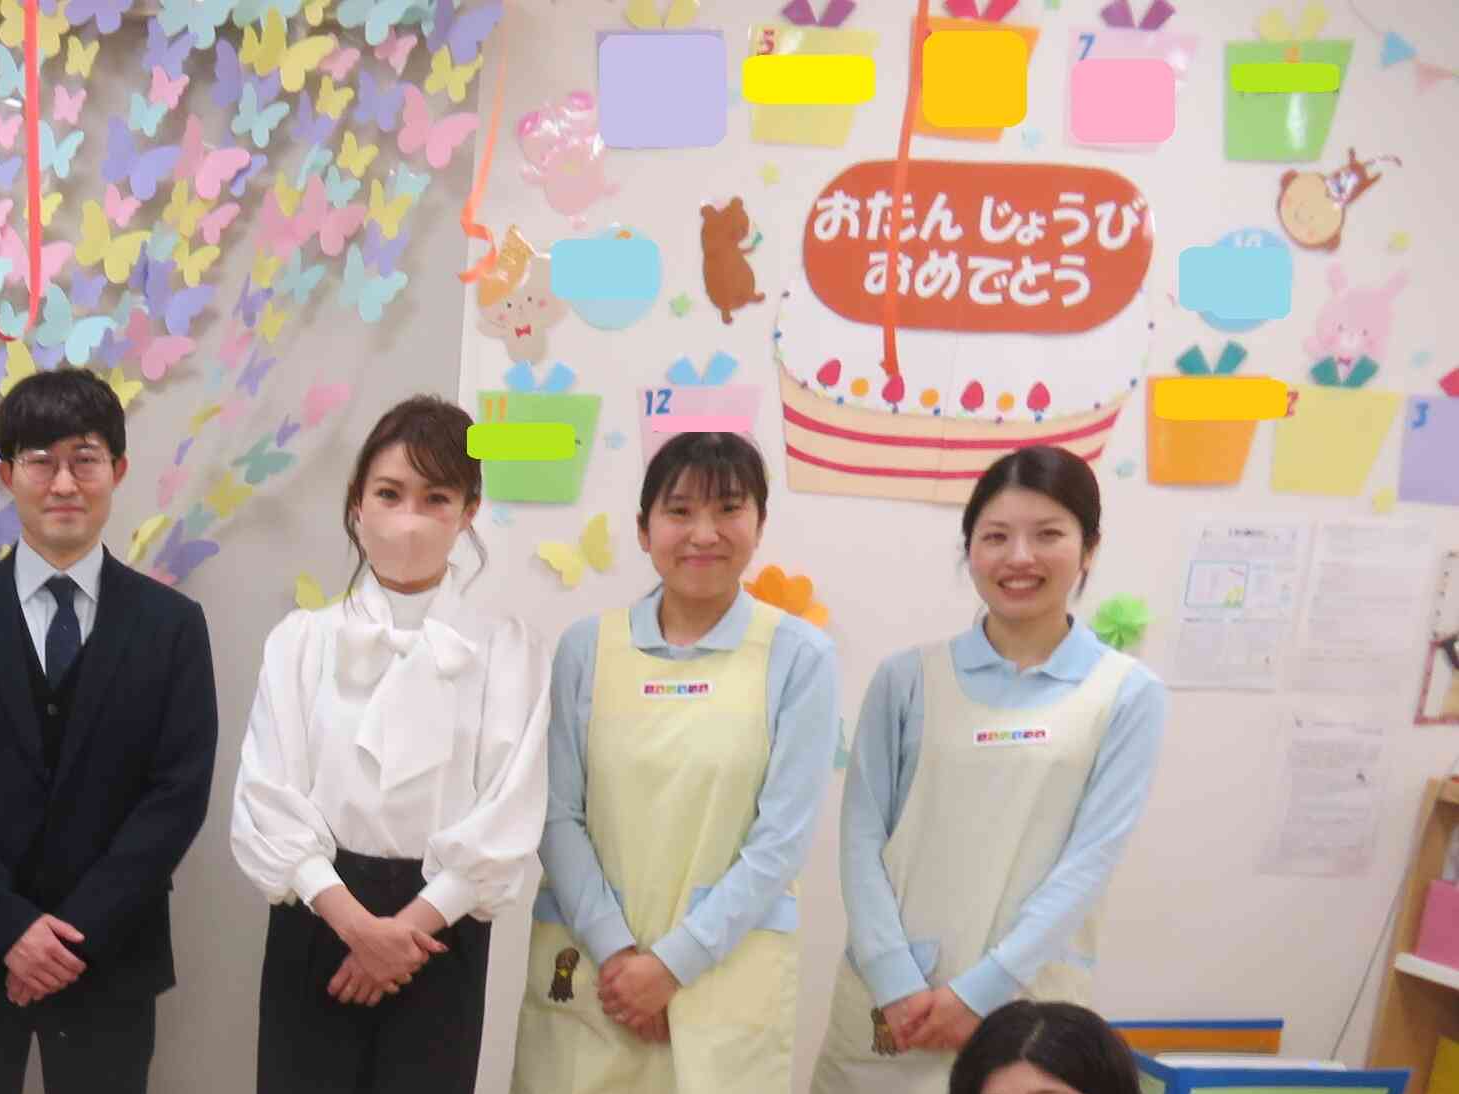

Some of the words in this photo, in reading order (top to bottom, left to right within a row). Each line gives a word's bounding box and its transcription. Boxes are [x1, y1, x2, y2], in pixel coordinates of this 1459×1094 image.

[1078, 33, 1096, 61] 7
[863, 250, 1092, 307] おめでとう
[644, 388, 673, 416] 12
